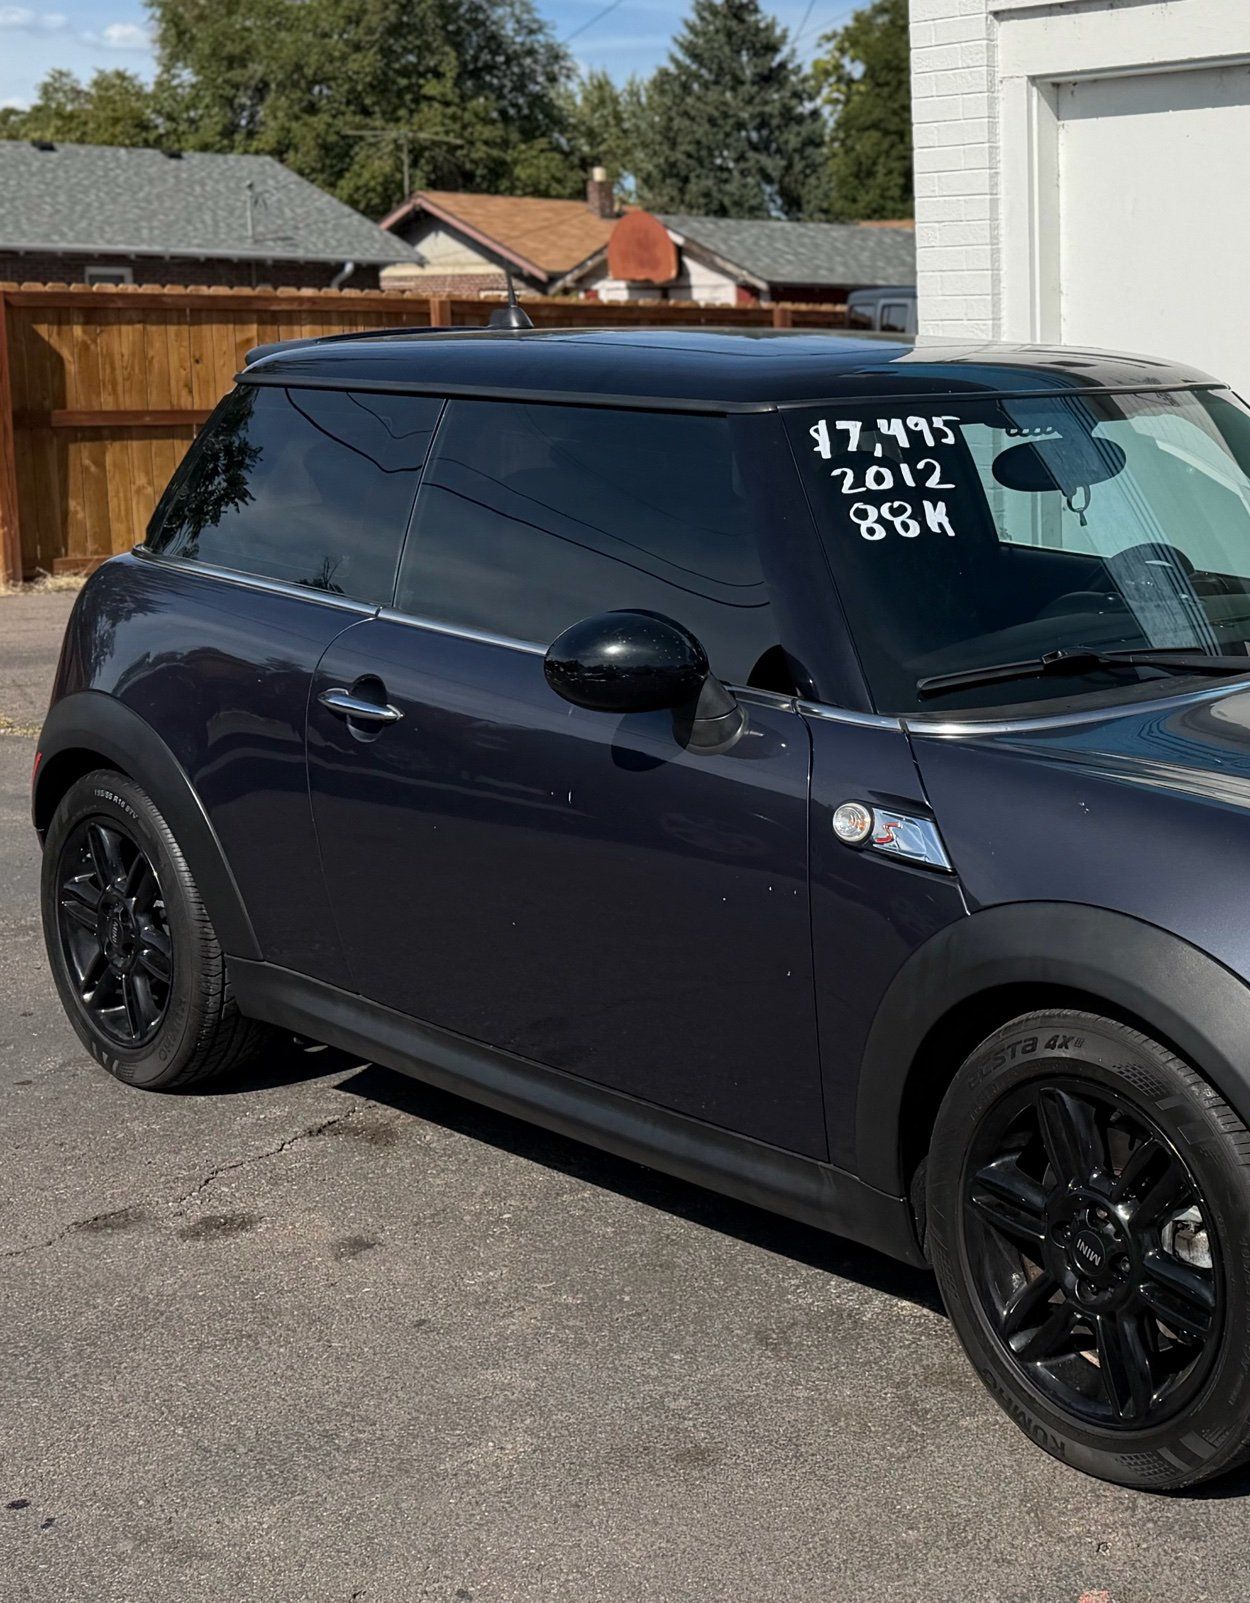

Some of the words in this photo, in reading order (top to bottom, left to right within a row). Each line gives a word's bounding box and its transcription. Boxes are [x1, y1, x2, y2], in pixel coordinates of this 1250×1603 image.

[809, 415, 961, 460] $7,495
[830, 458, 956, 494] 2012
[849, 500, 956, 541] 88K
[1076, 1238, 1102, 1267] MINI
